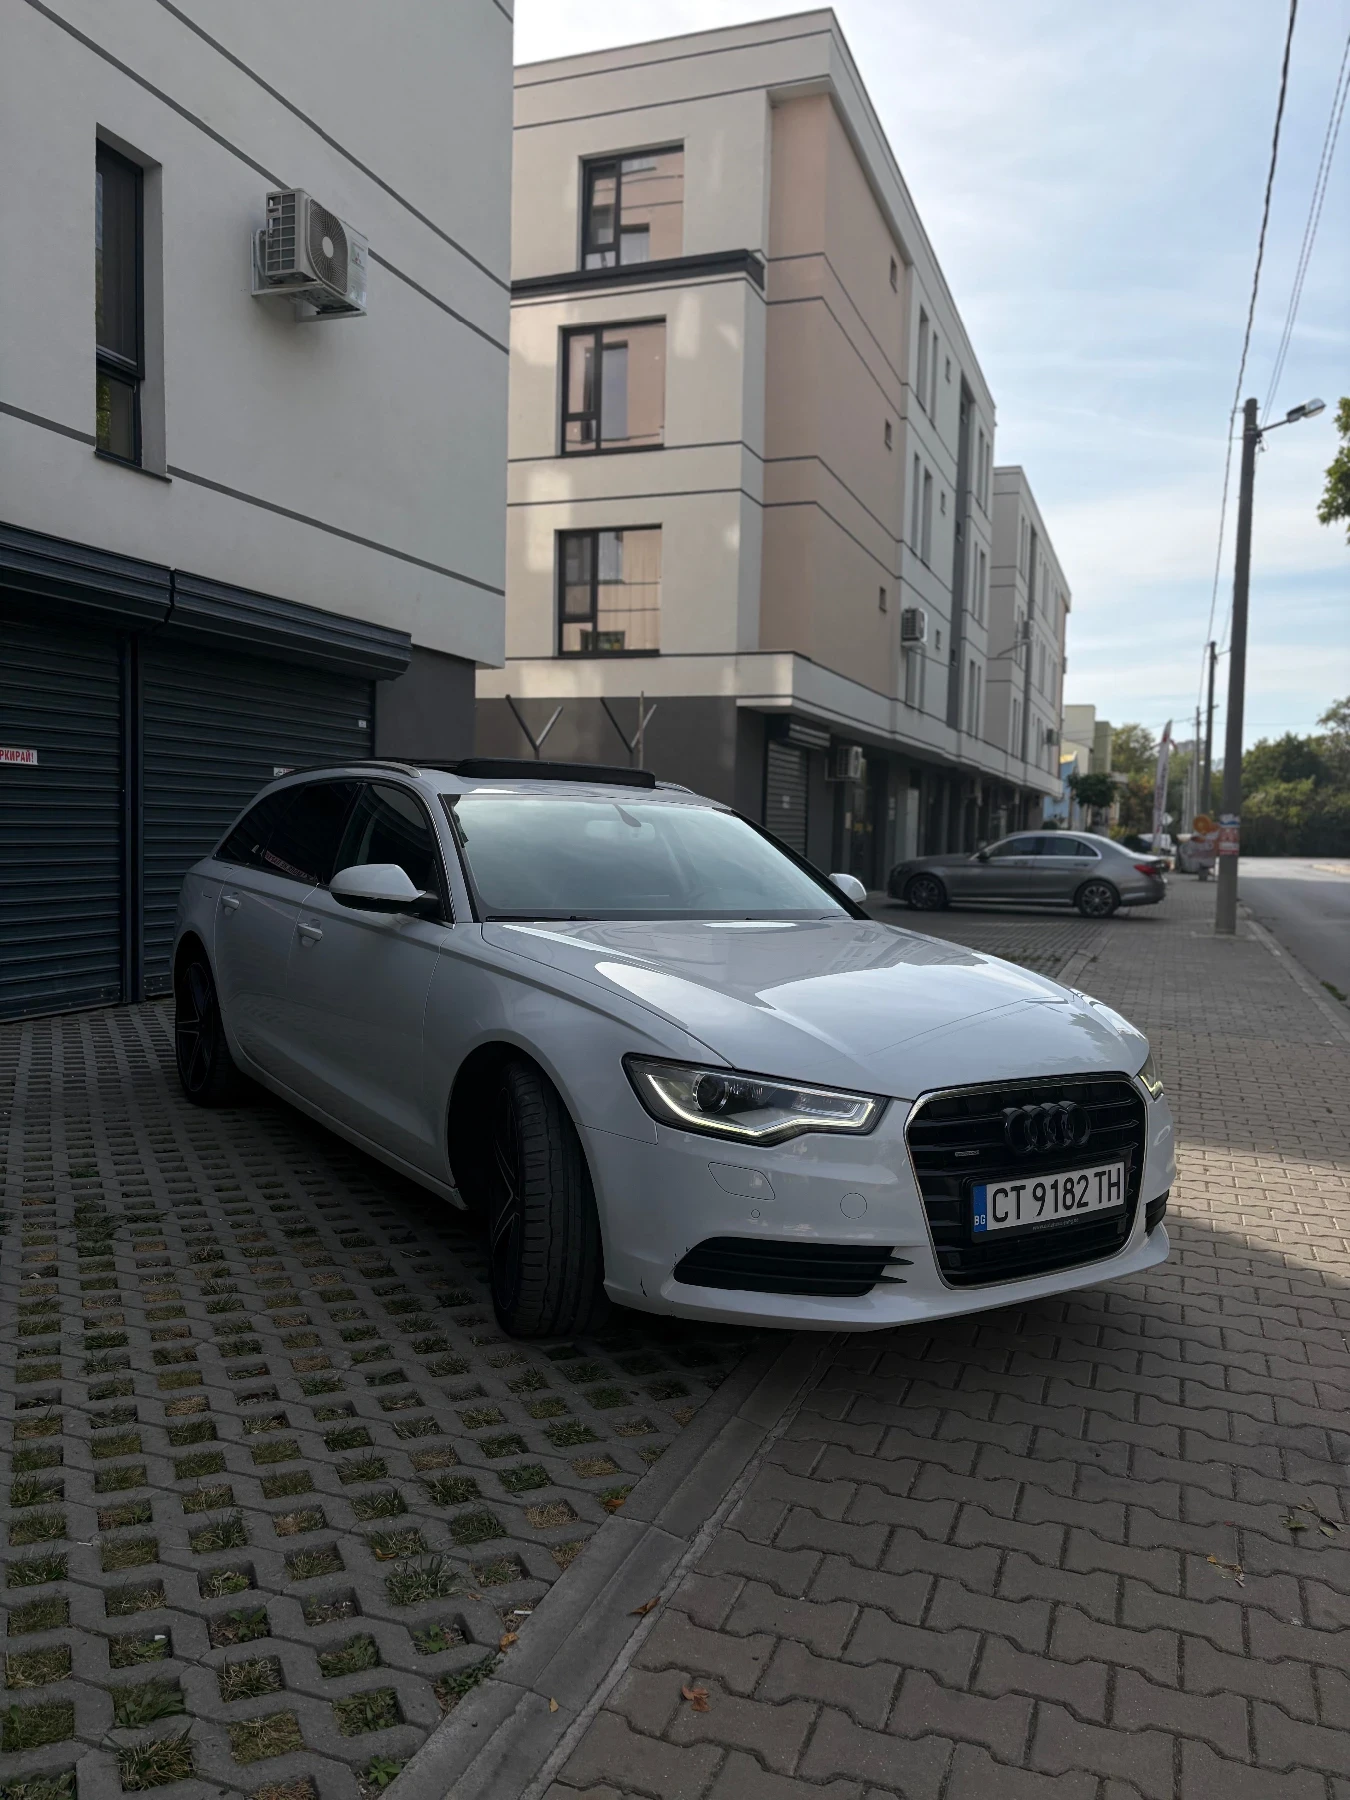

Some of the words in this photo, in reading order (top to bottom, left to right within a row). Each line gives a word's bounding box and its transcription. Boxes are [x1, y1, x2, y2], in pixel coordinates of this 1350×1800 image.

[992, 1185, 1026, 1222] CT
[1032, 1174, 1089, 1217] 9182
[1094, 1167, 1121, 1204] TH
[974, 1214, 986, 1226] BG
